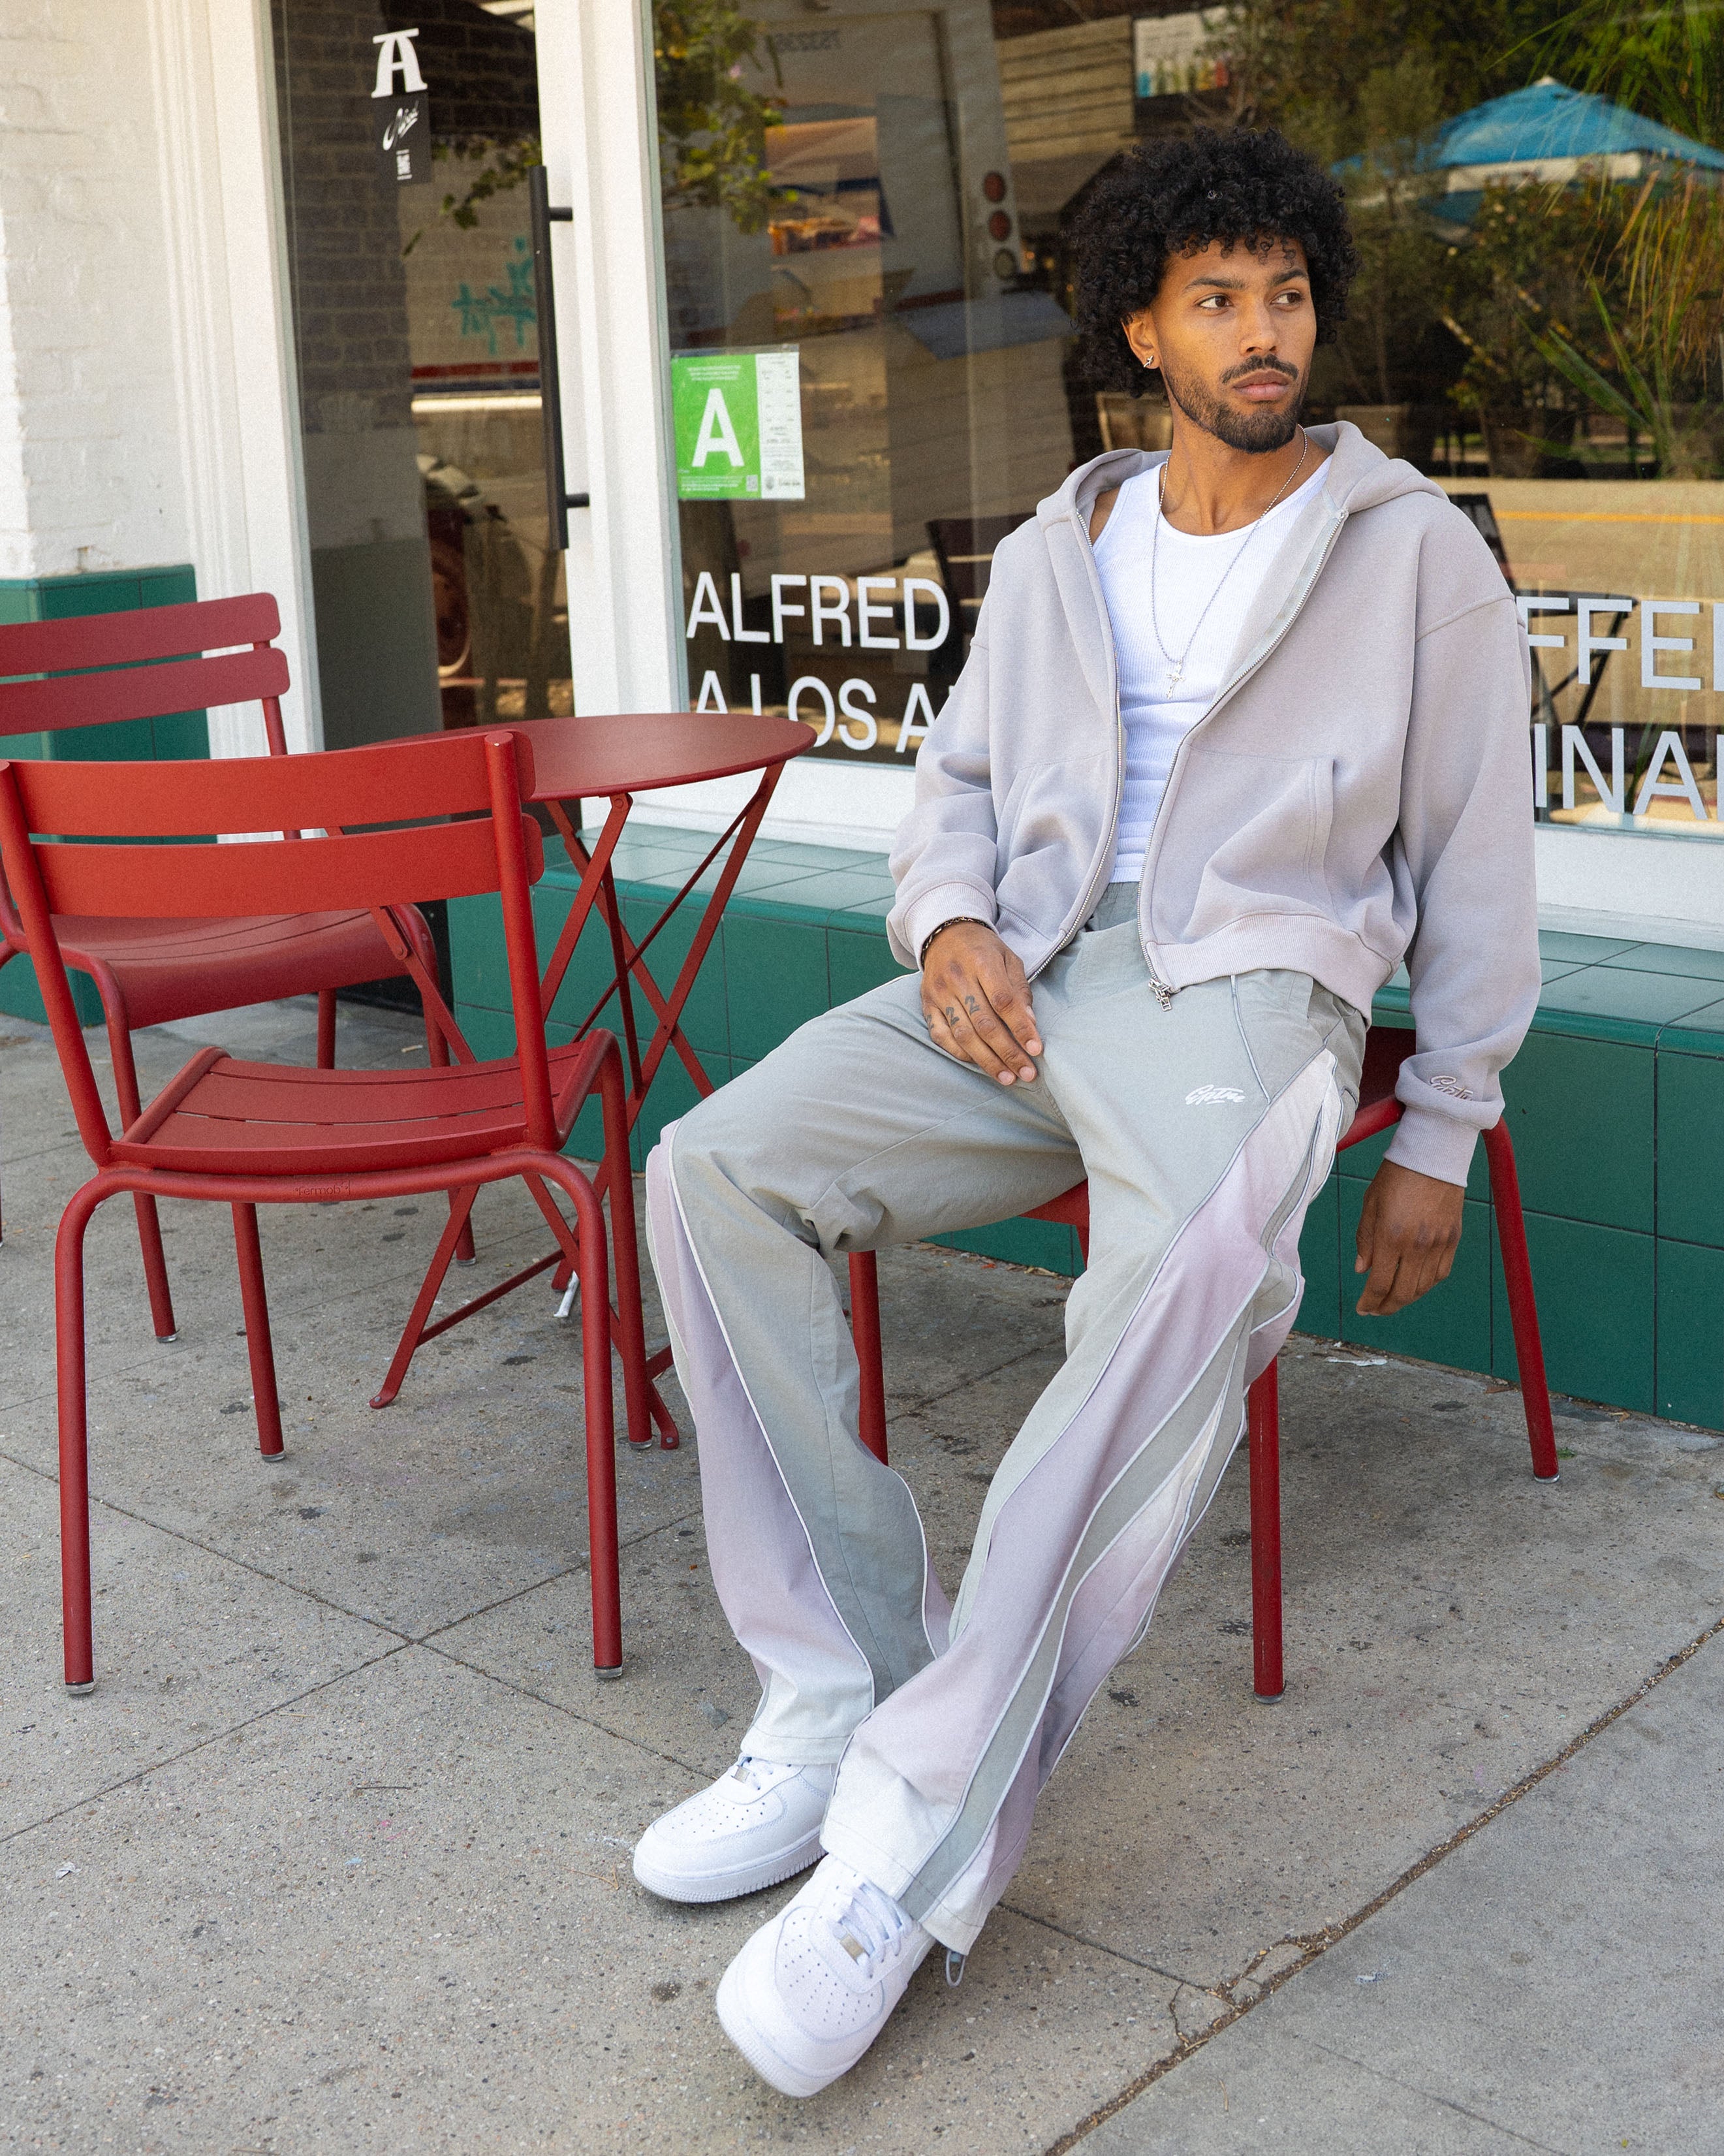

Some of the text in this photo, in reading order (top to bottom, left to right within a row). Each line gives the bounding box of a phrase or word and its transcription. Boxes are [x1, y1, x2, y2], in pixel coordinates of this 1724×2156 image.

[371, 27, 428, 98] A
[691, 388, 745, 468] A
[686, 571, 1724, 691] ALFRED FFE
[1534, 723, 1724, 822] INA
